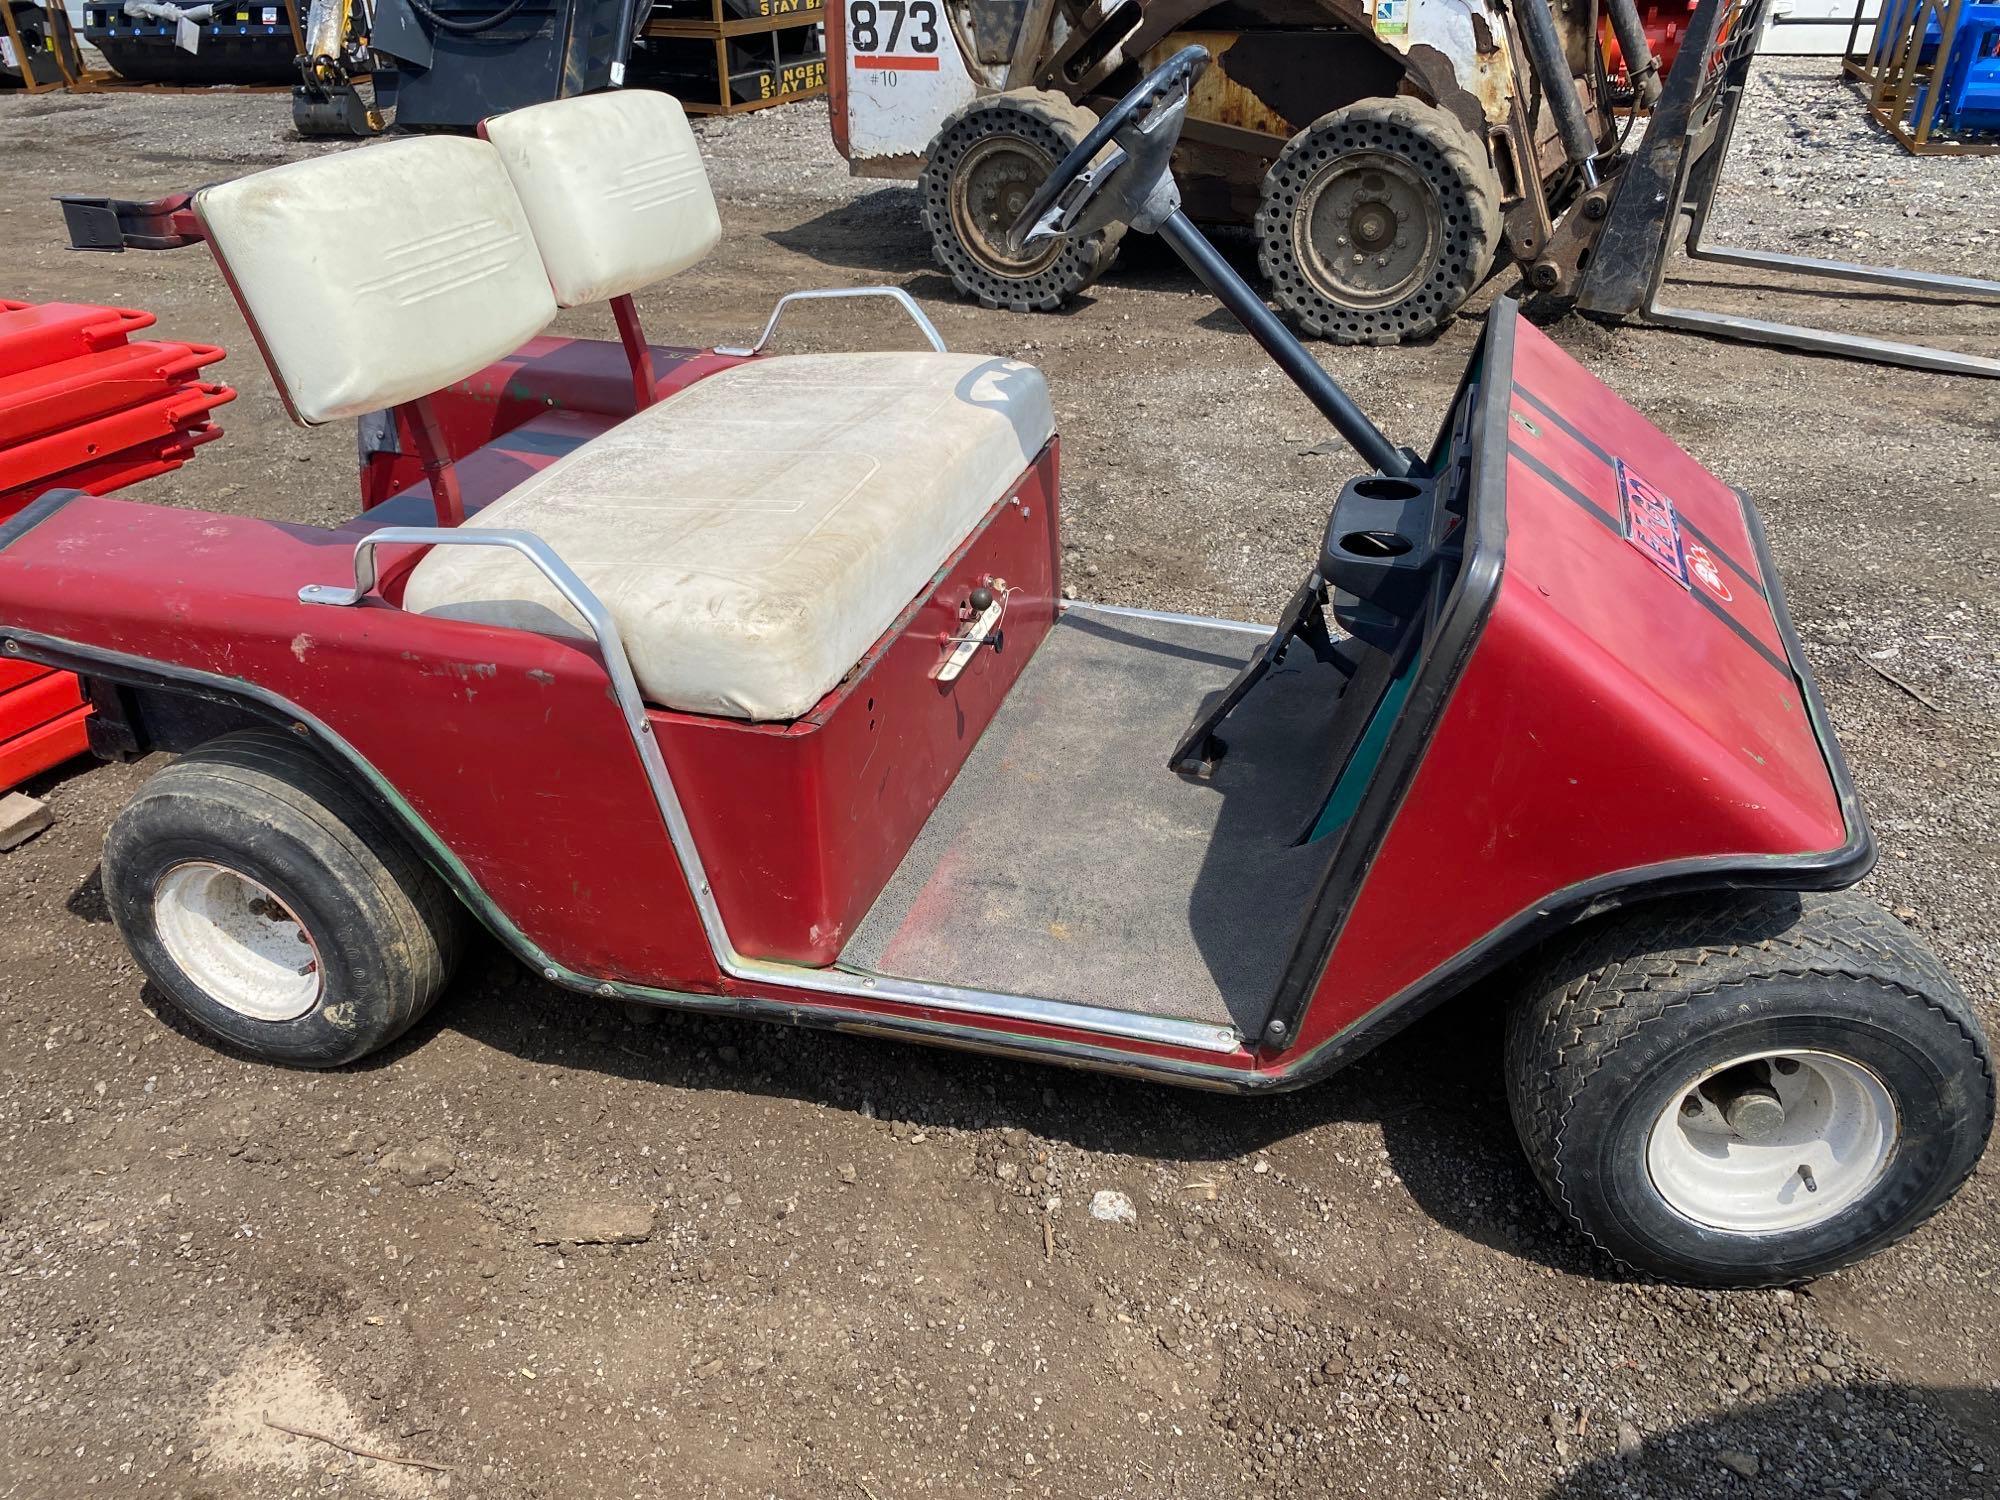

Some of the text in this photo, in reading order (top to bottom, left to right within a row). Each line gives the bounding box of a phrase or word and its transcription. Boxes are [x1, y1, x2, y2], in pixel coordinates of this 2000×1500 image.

[850, 1, 938, 53] 873
[760, 63, 825, 87] DNGER
[870, 71, 897, 87] #10
